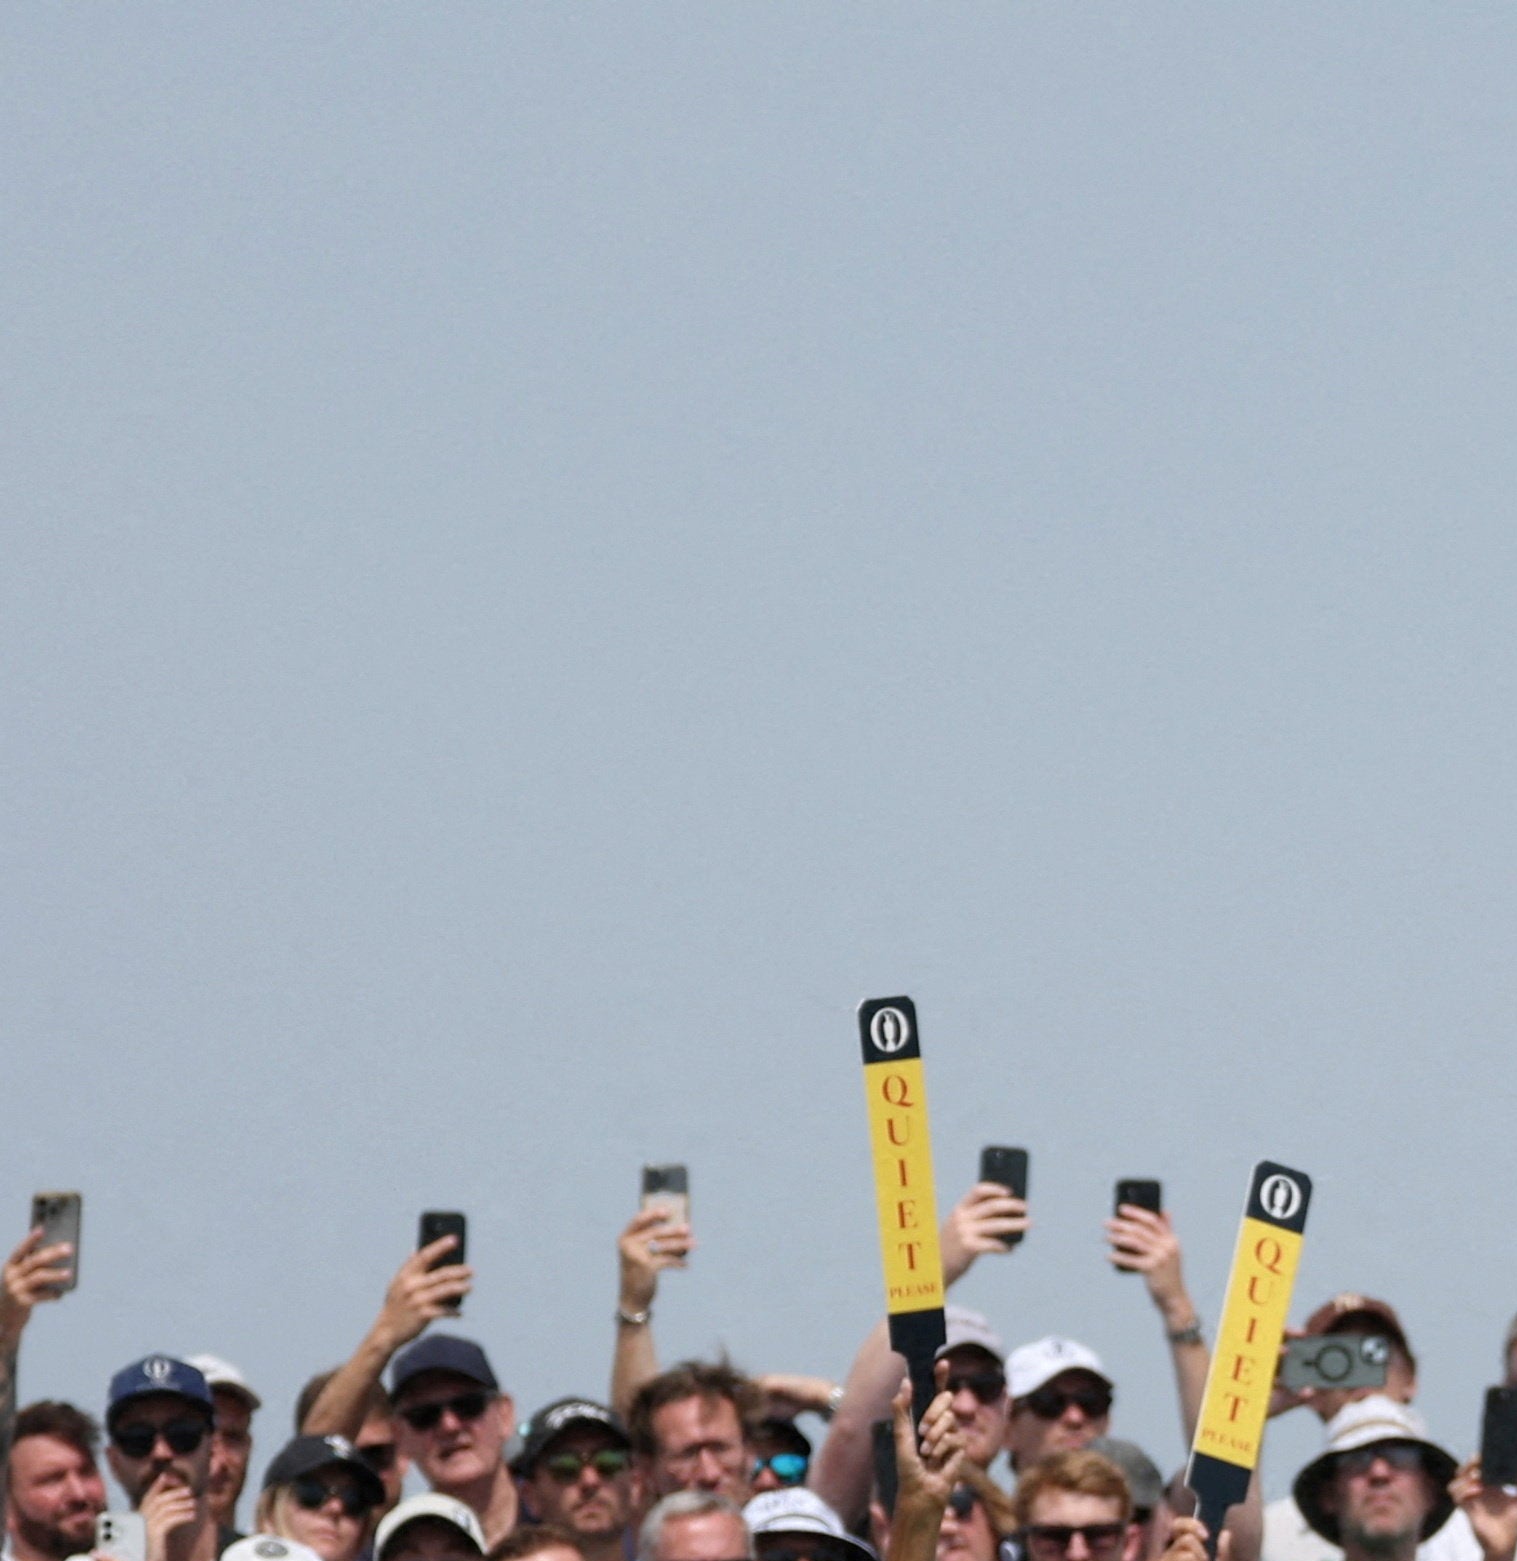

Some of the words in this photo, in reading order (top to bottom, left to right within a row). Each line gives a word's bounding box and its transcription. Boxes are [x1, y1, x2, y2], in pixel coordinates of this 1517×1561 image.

[882, 1074, 921, 1270] QUIET
[889, 1282, 937, 1298] PLEASE
[1224, 1237, 1282, 1422] QUIET
